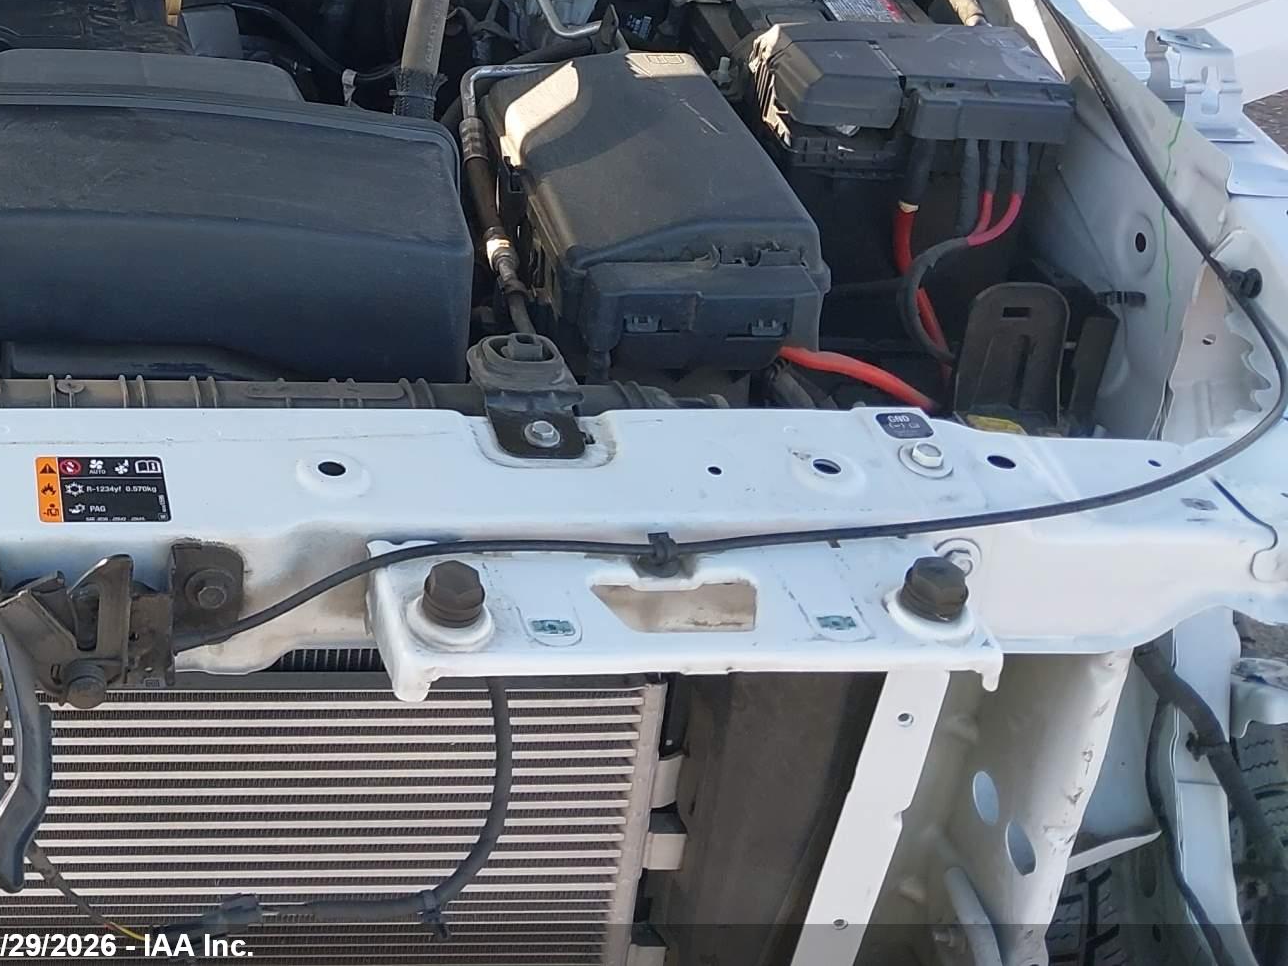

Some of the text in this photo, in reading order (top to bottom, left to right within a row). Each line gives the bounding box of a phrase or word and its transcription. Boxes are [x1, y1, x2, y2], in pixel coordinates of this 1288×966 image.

[887, 415, 910, 423] GND
[86, 485, 157, 494] R-1234yf 0.570kg
[89, 505, 106, 513] PAG
